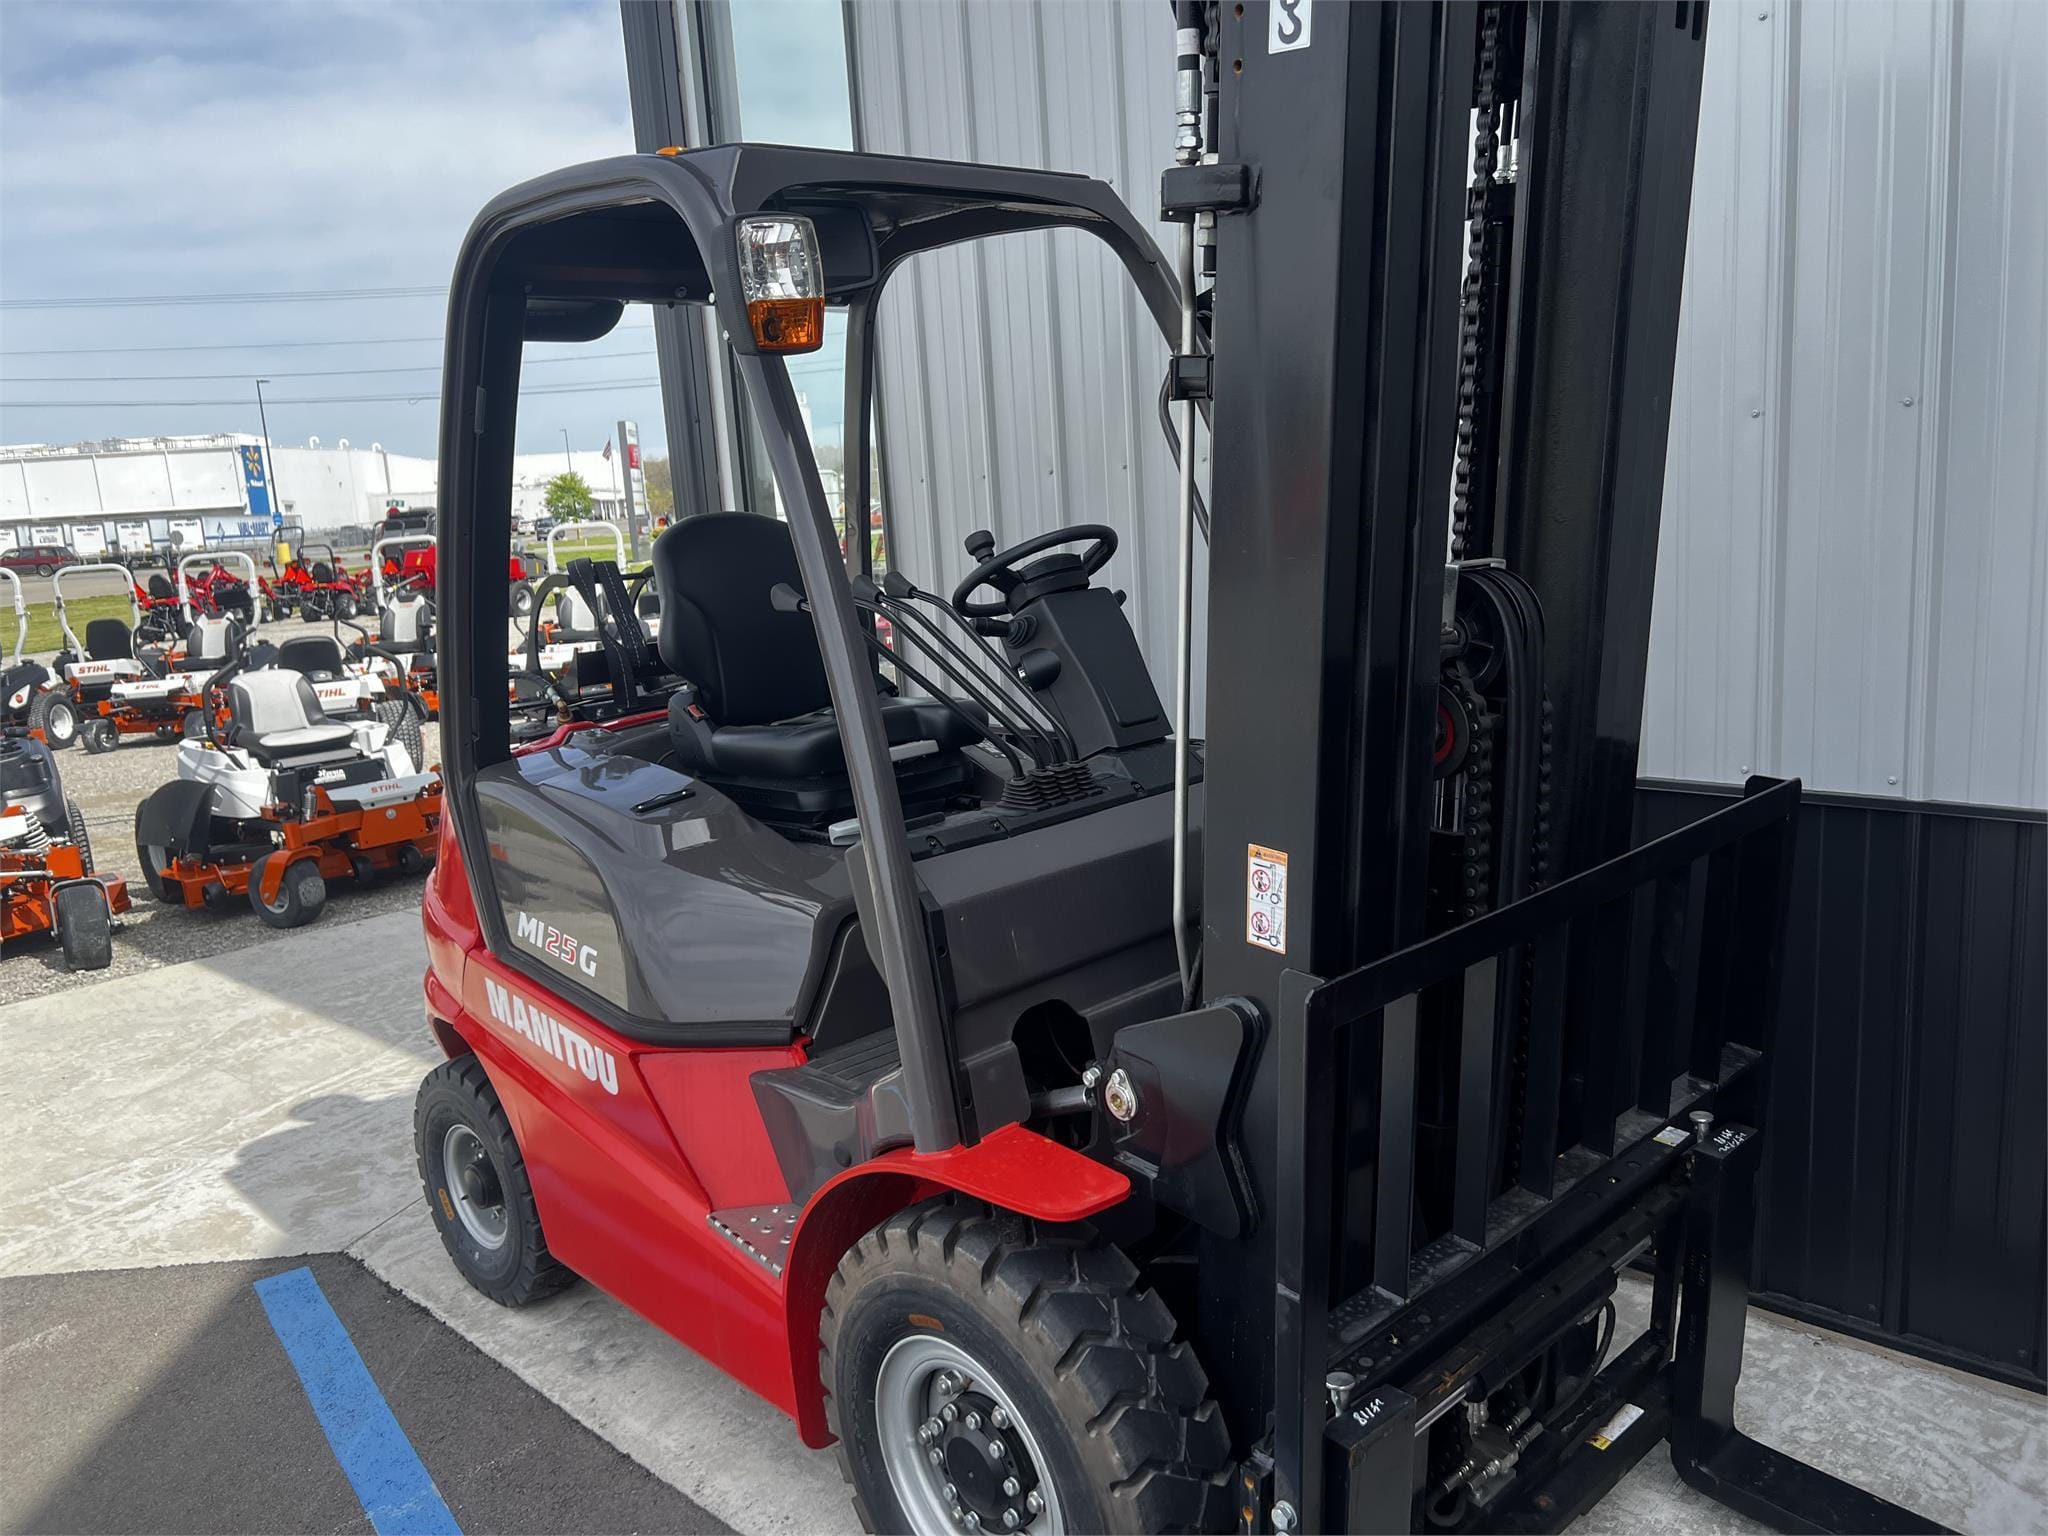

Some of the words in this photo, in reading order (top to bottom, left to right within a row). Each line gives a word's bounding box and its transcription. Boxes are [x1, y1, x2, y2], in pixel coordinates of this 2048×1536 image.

[78, 664, 111, 674] STIHL
[317, 688, 346, 698] TIHL
[370, 783, 403, 794] STIHL
[484, 976, 619, 1096] MANITOU
